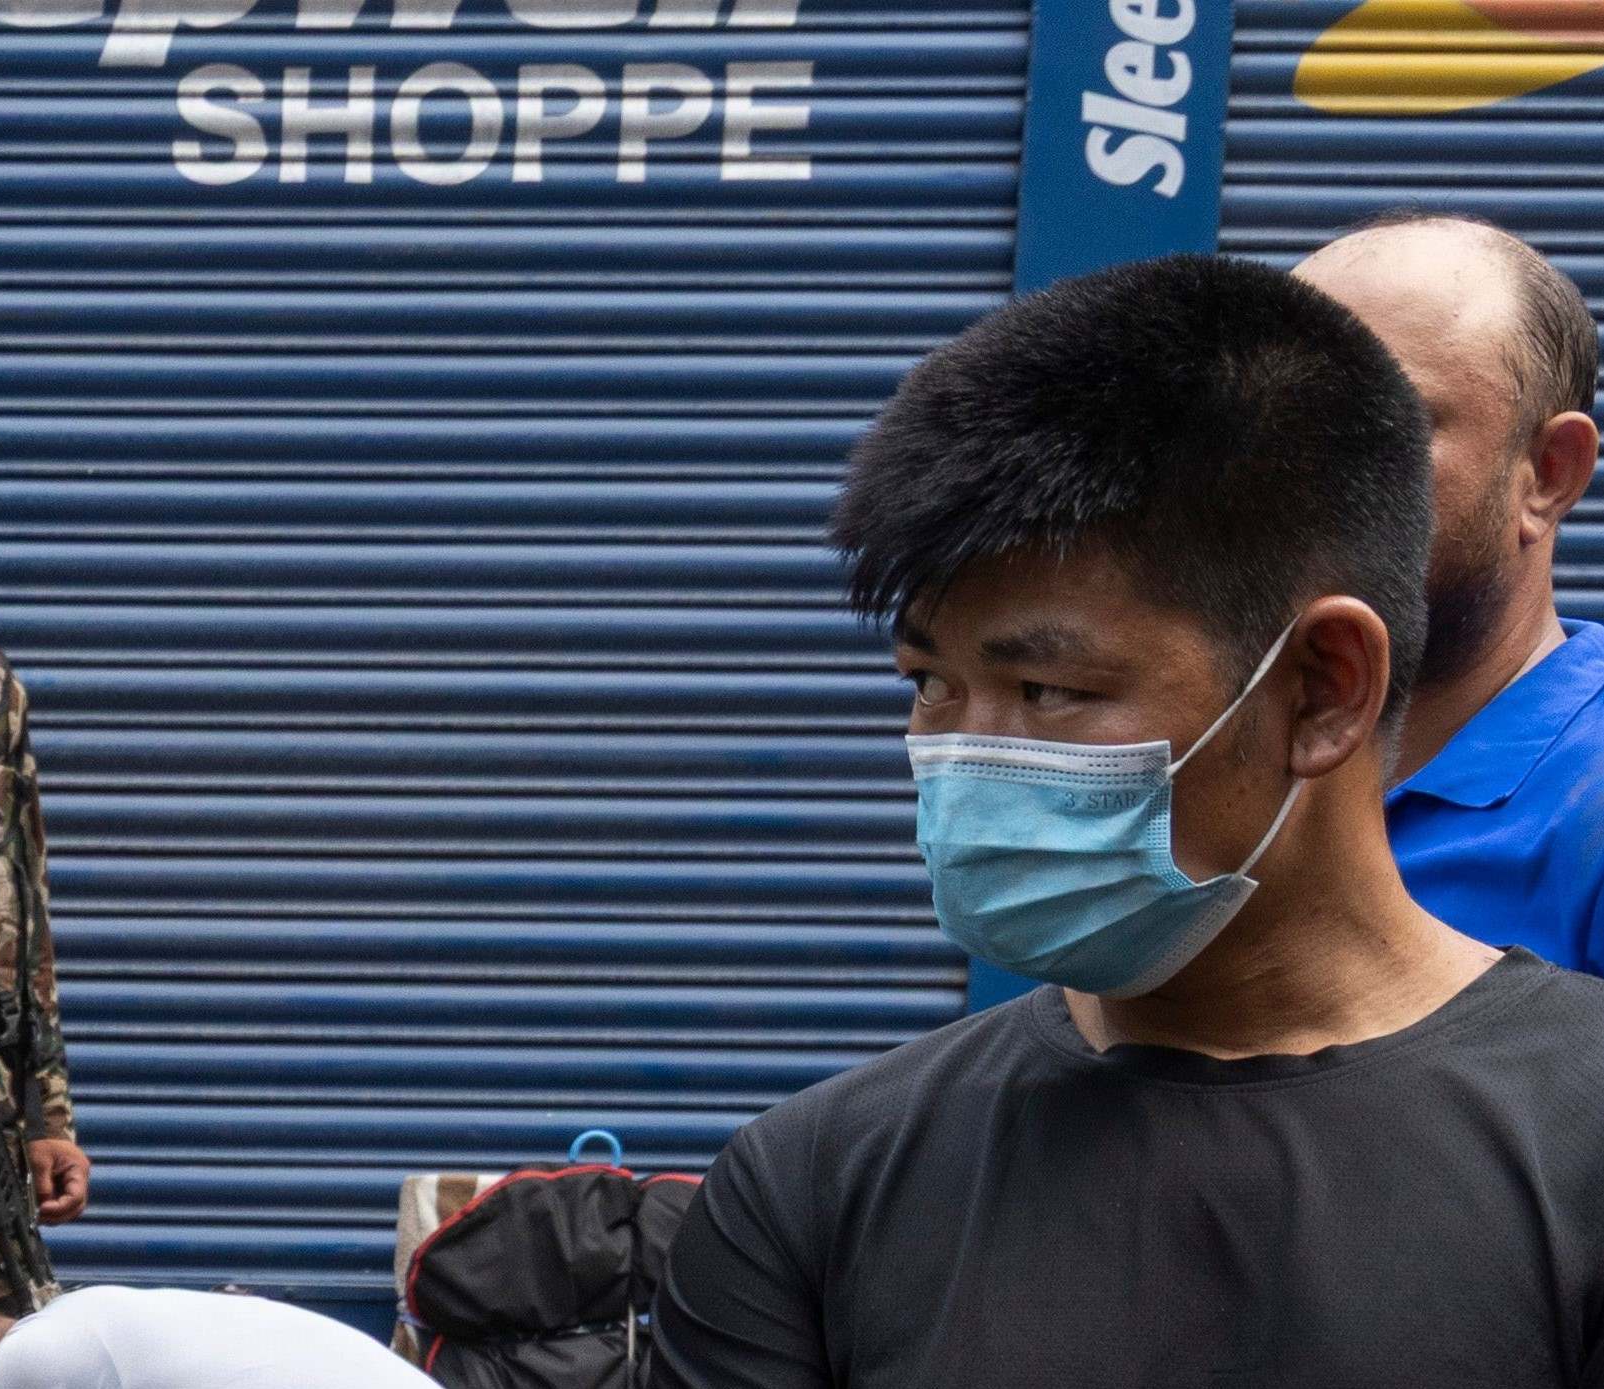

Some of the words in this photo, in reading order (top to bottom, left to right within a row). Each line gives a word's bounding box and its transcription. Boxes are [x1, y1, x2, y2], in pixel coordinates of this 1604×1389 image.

[172, 62, 814, 185] SHOPPE
[1065, 791, 1076, 809] 3
[1088, 790, 1138, 809] STAR
